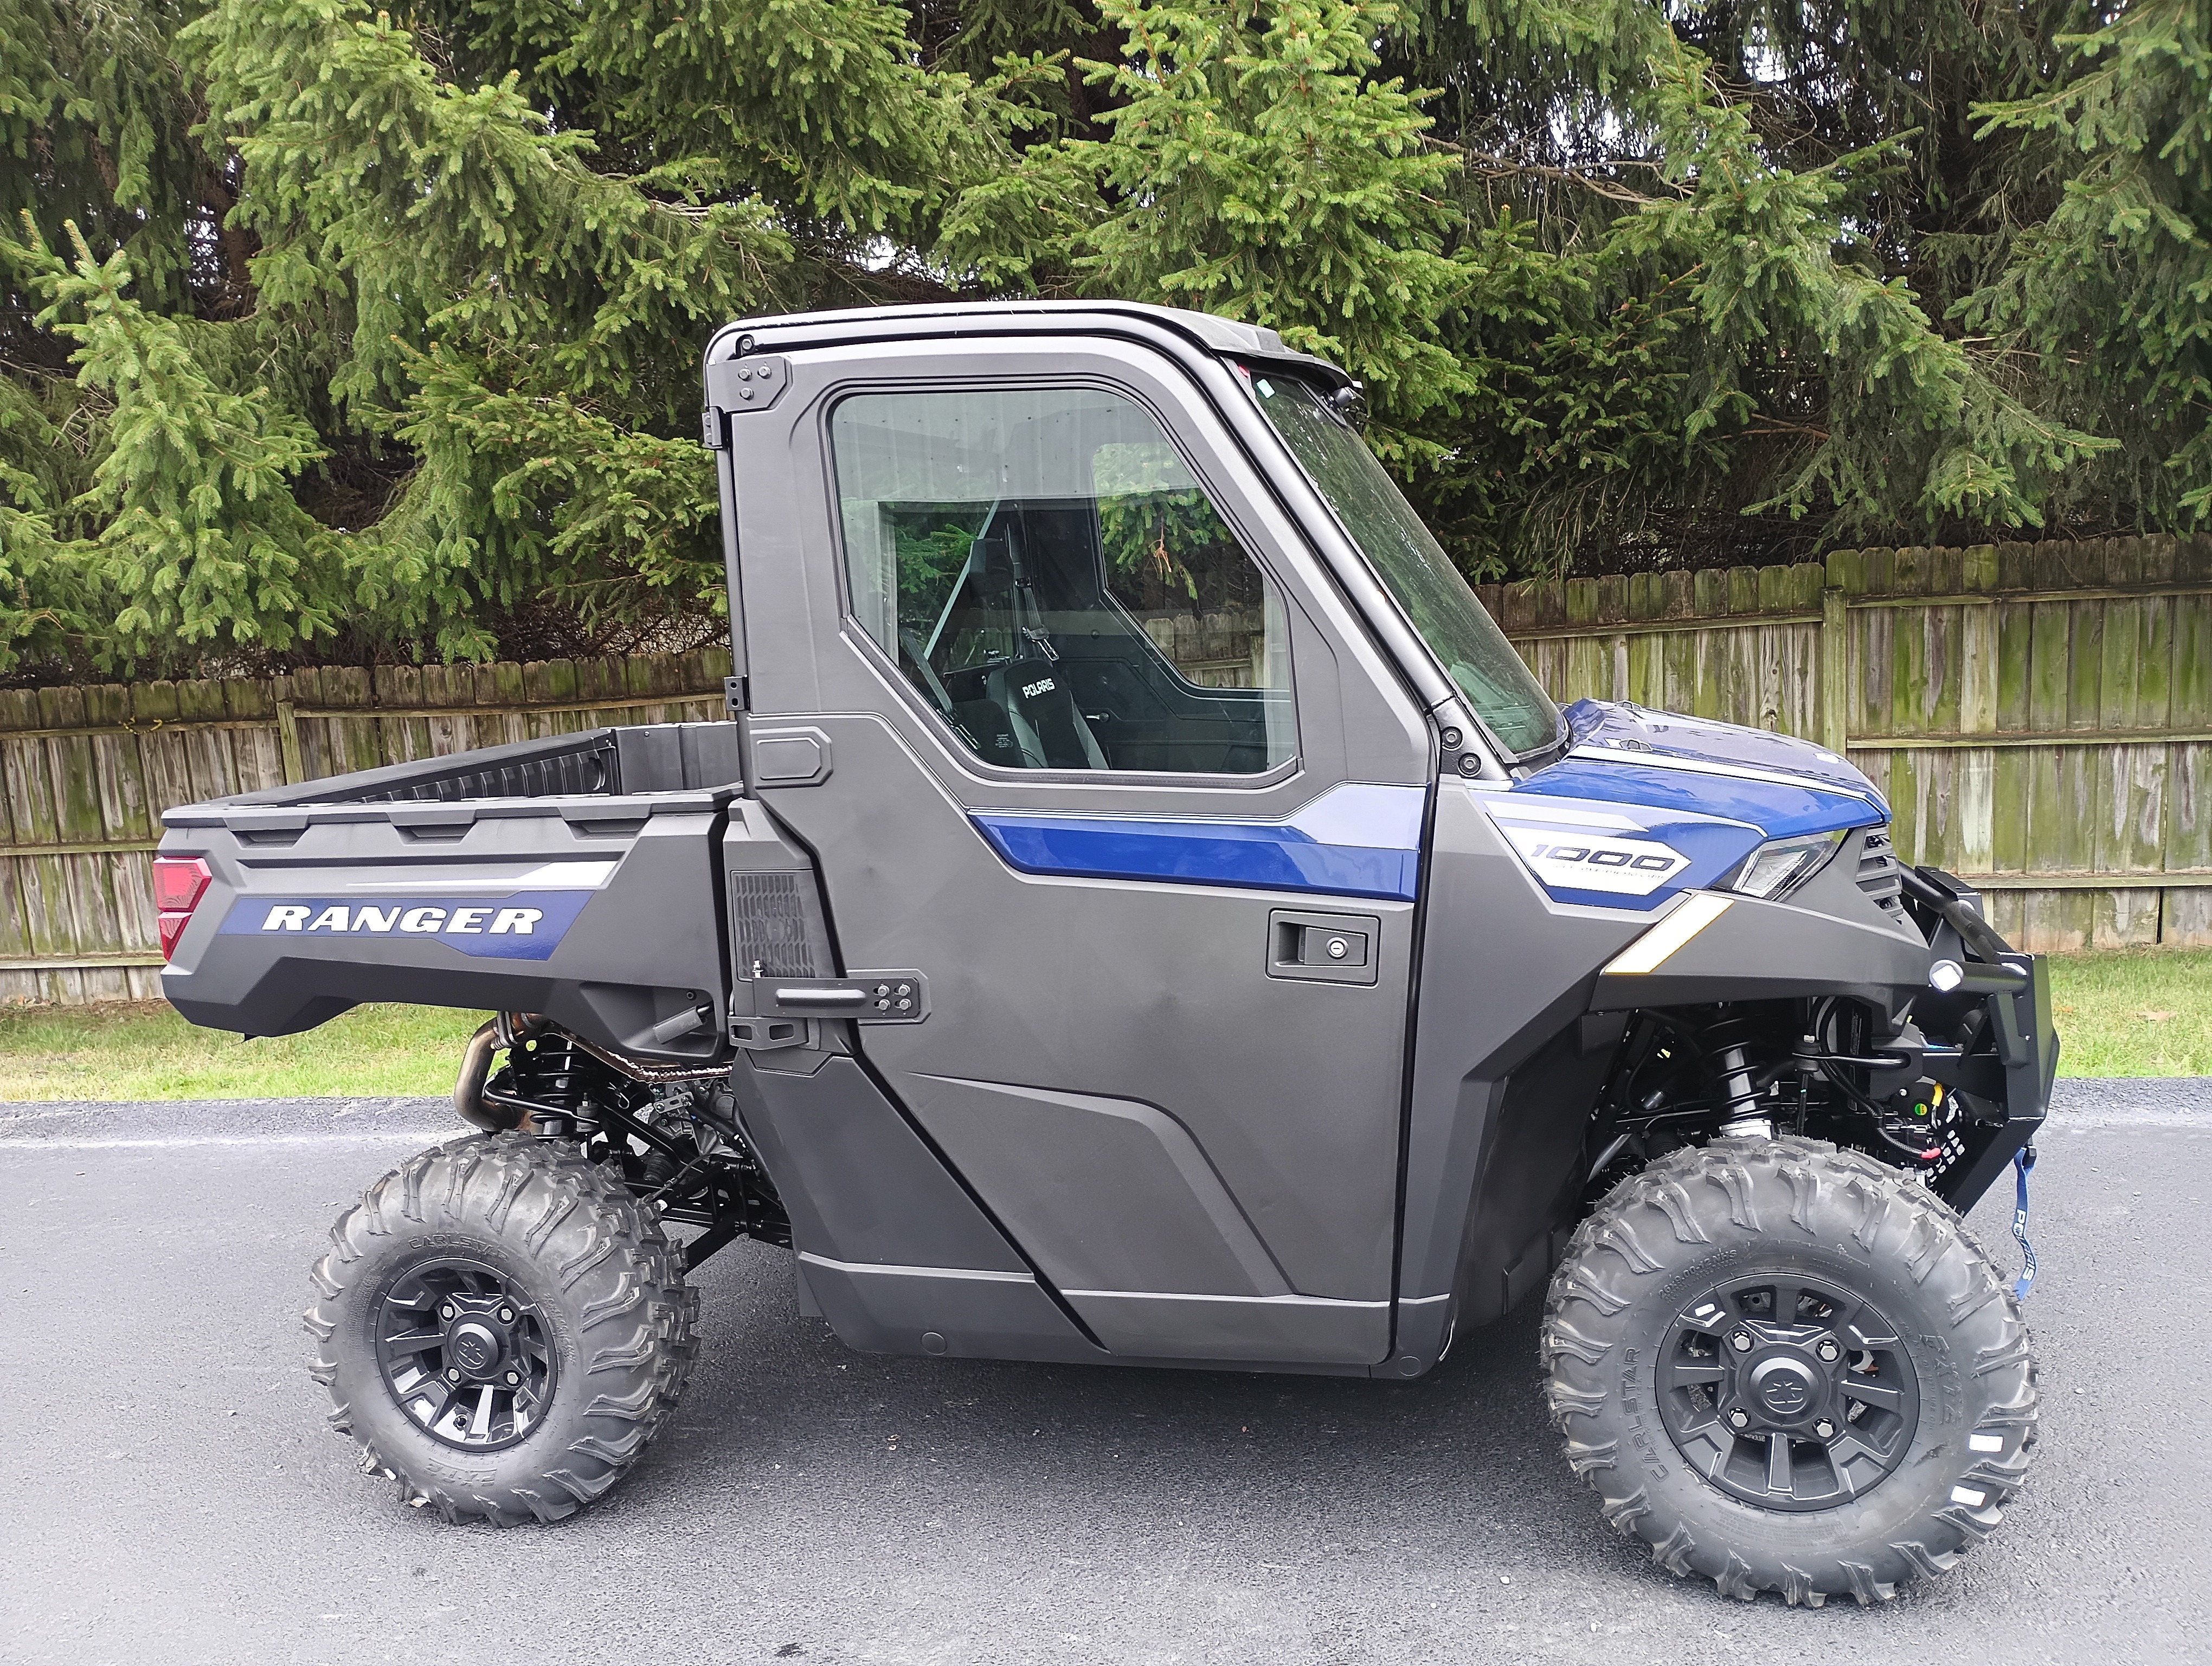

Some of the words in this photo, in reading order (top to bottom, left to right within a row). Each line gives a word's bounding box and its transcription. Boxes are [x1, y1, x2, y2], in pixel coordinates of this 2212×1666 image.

[1022, 678, 1055, 699] POLARIS
[1531, 844, 1675, 872] 1000
[261, 905, 543, 934] RANGER
[2013, 1209, 2035, 1281] POLARIS
[1621, 1347, 1669, 1483] CARLSTAR
